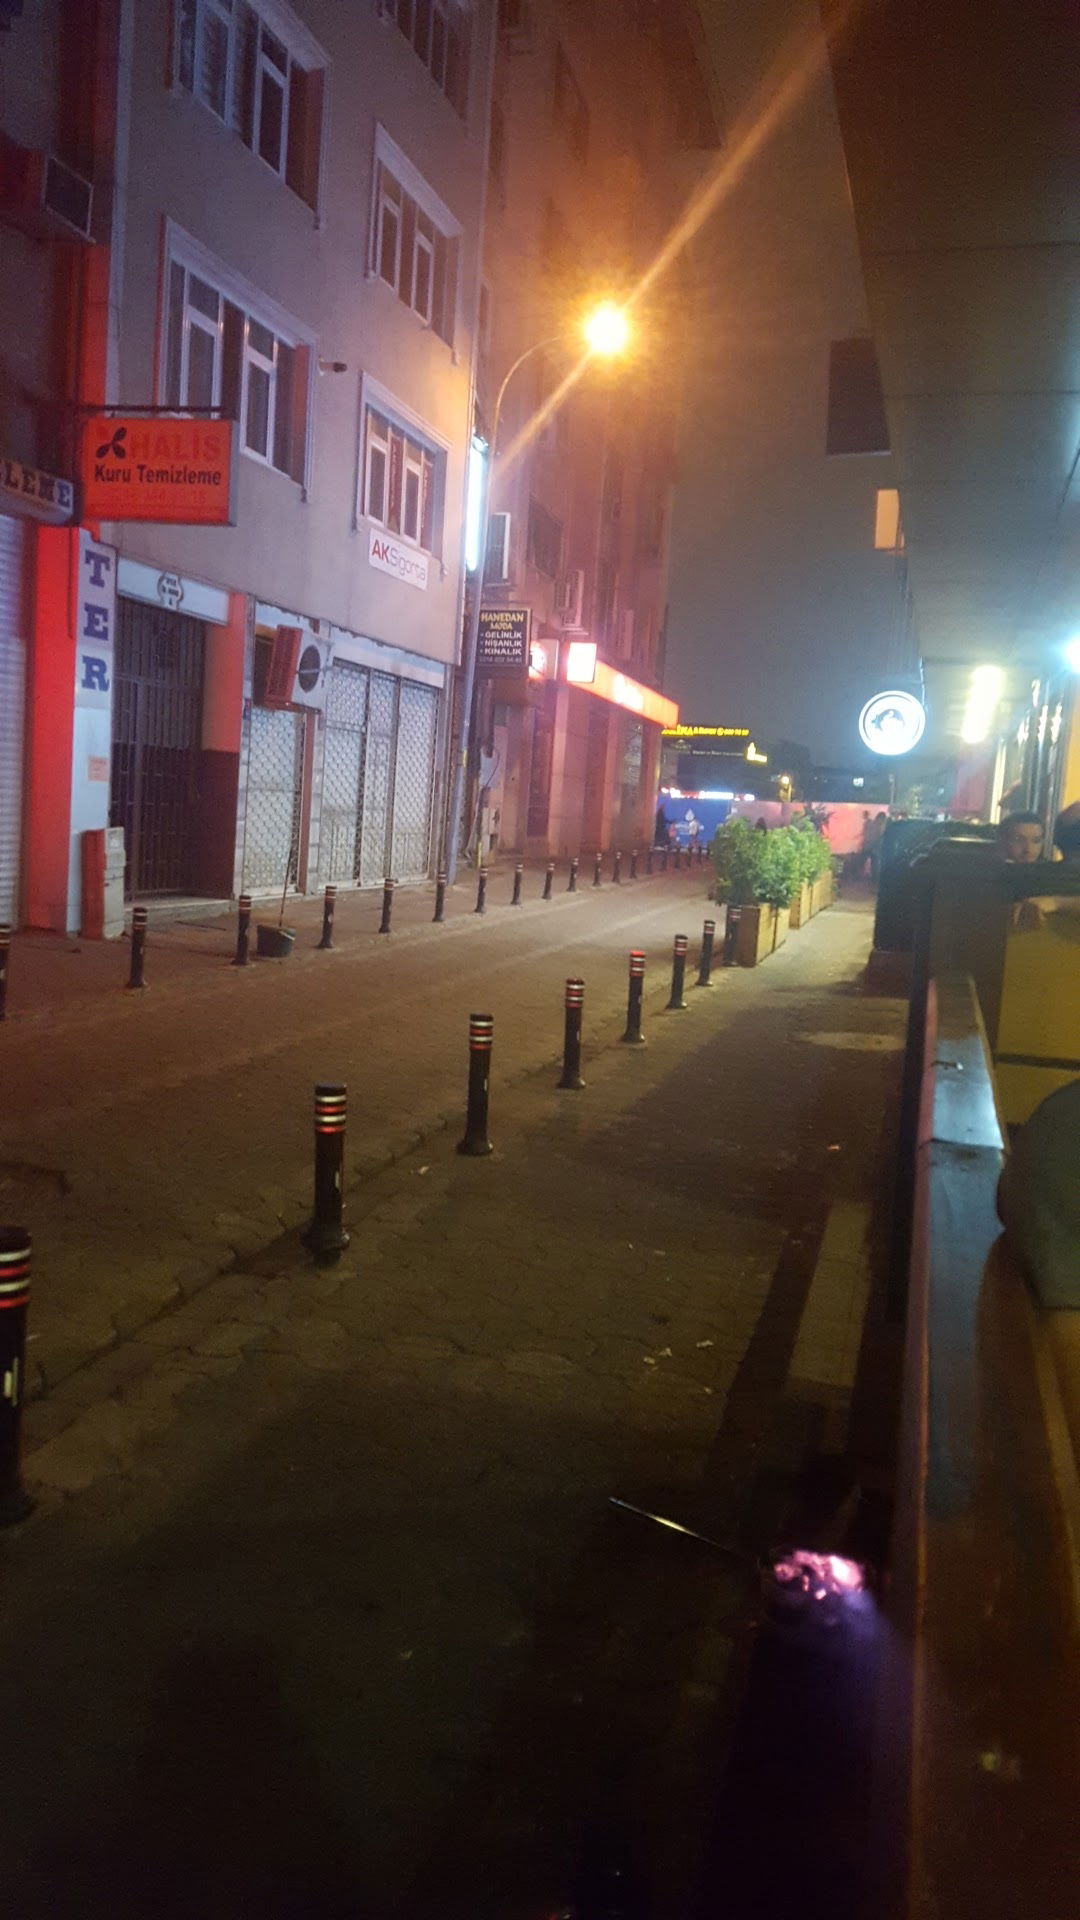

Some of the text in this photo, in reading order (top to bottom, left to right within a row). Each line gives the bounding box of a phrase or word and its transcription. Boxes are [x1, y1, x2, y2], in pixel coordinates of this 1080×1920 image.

[0, 459, 70, 508] LEME
[94, 464, 222, 485] Kuru Temizleme
[480, 613, 524, 623] HANEDAN
